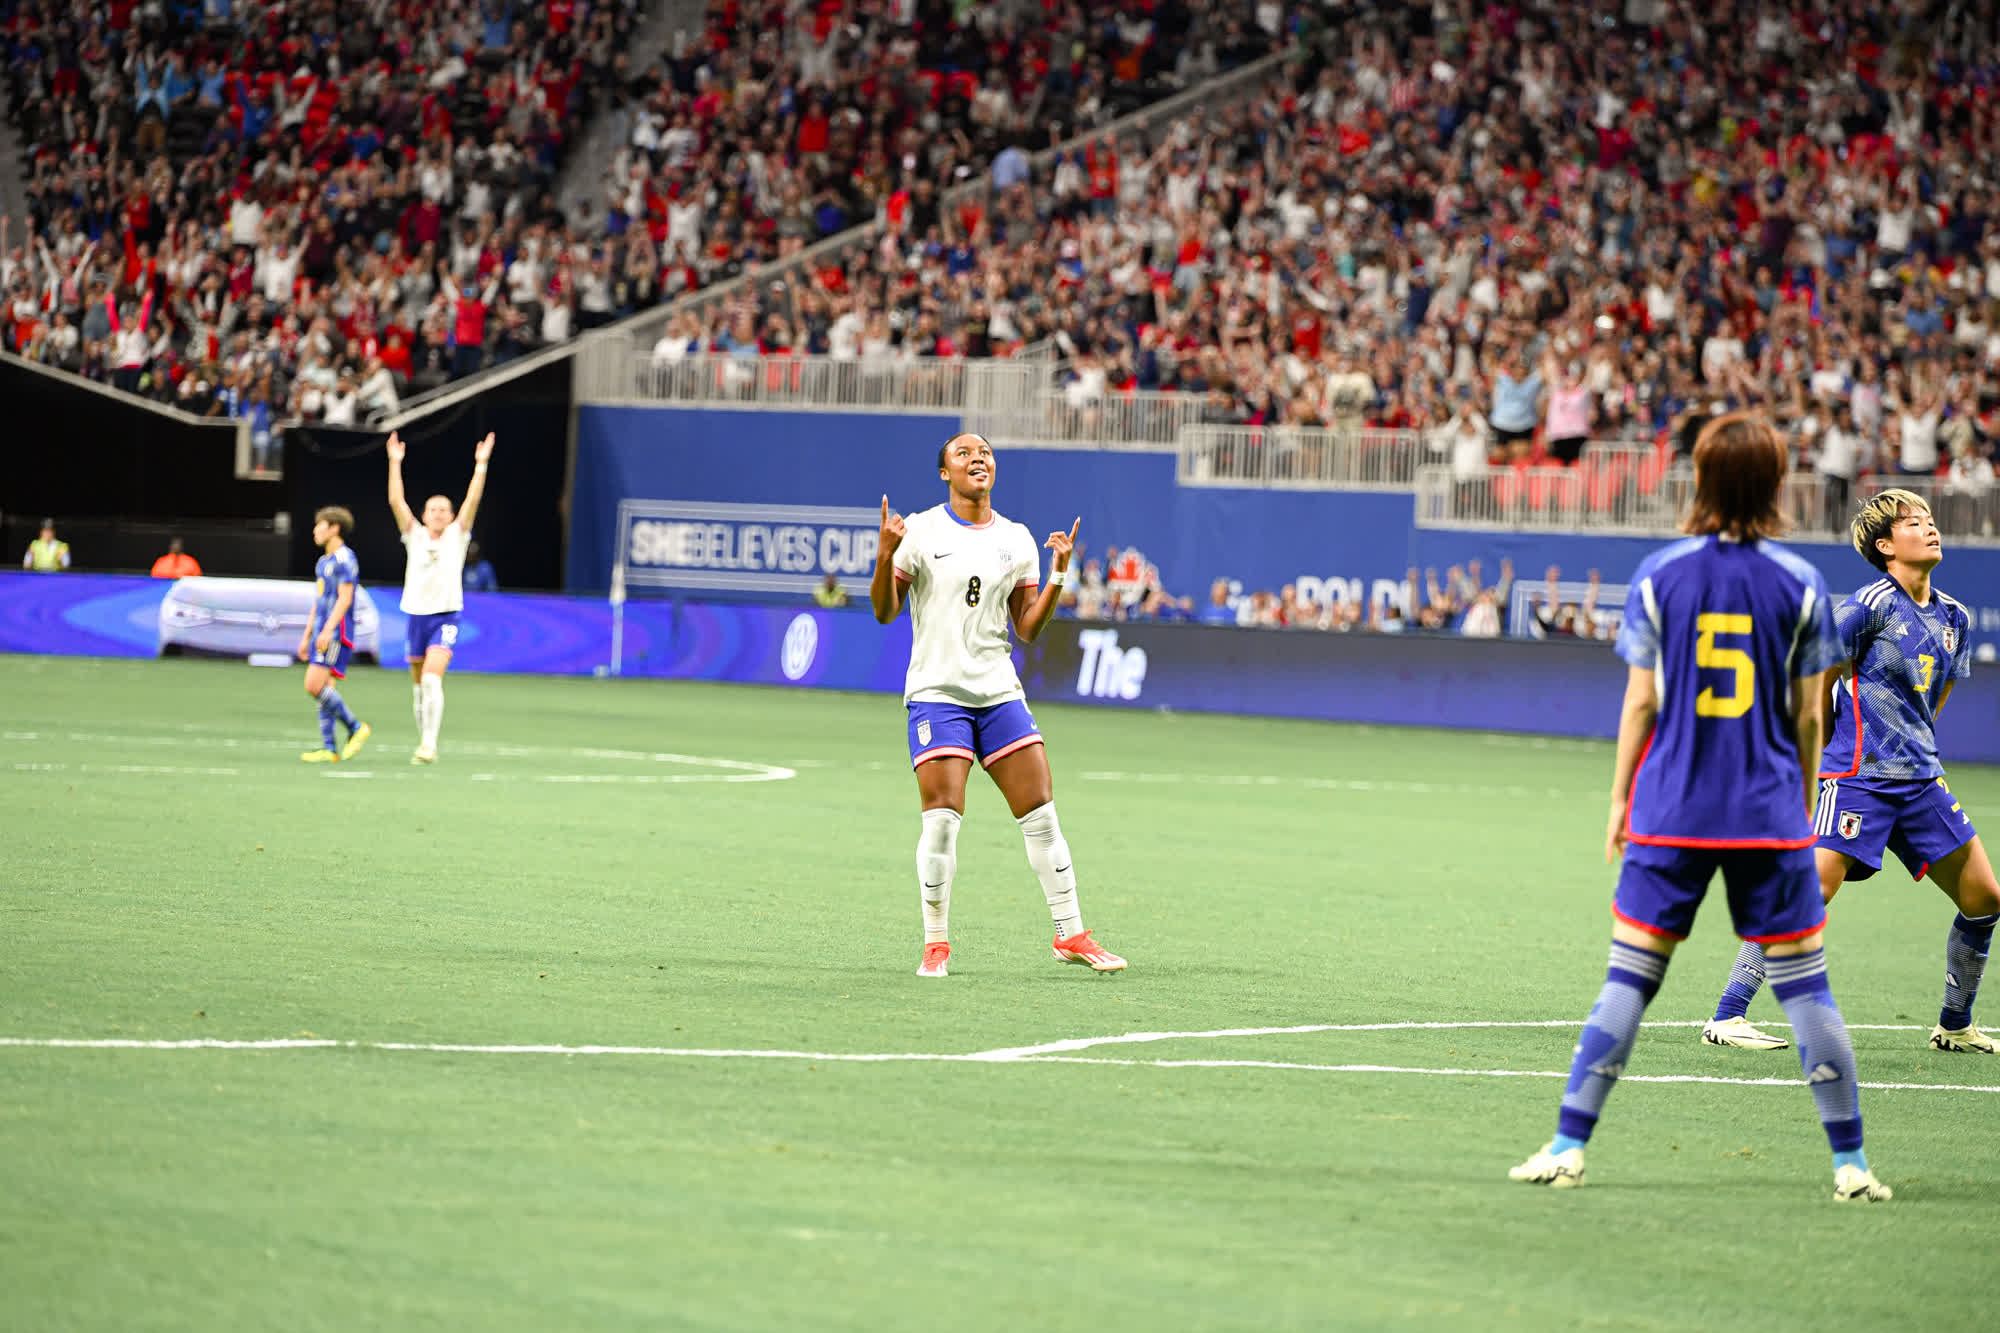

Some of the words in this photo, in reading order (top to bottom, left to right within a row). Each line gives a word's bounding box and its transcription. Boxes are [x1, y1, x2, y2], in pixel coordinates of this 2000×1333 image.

[632, 520, 817, 572] SHEBELIEVES
[820, 528, 878, 574] CUP
[965, 576, 981, 607] 8
[1077, 629, 1147, 700] The
[1696, 613, 1755, 718] 5
[1913, 654, 1935, 692] 3
